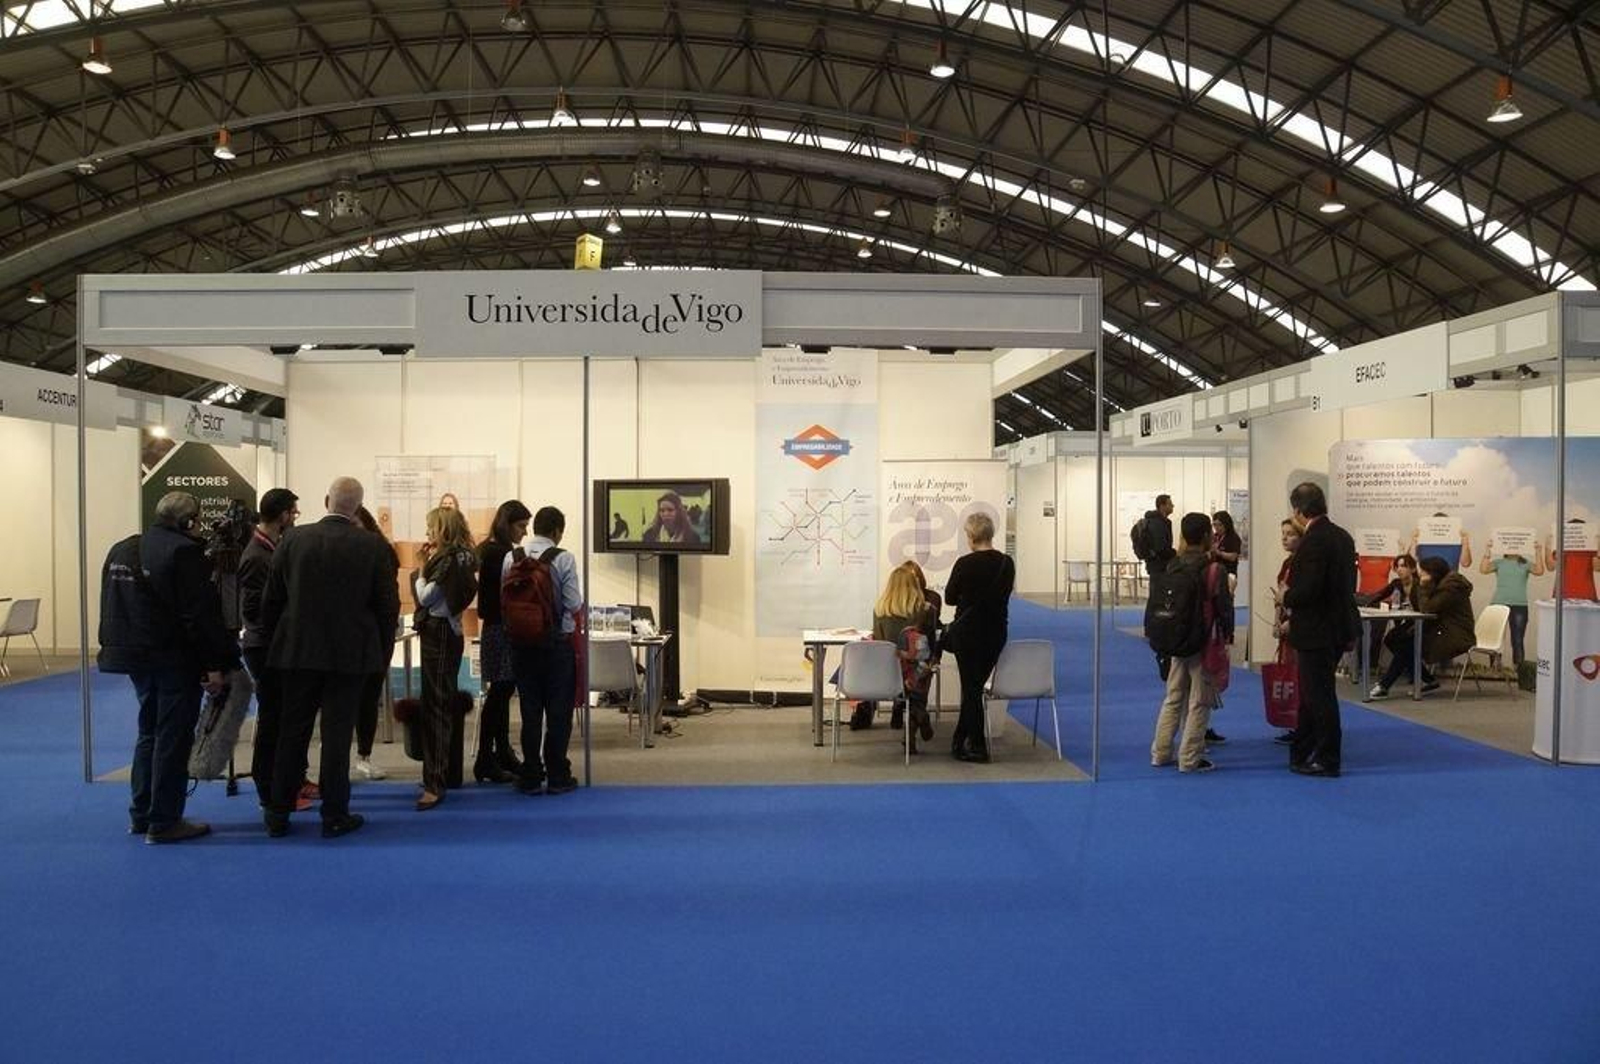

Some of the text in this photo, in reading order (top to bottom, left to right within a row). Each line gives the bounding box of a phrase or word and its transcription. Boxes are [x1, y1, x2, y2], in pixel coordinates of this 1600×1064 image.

[1355, 361, 1386, 383] EFACEC
[37, 388, 77, 407] ACCENTUR
[1312, 395, 1321, 411] B1
[1346, 469, 1431, 479] procuramos talentos
[166, 476, 229, 487] SECTORES
[1346, 480, 1361, 488] que
[1363, 478, 1391, 487] podem
[1393, 478, 1431, 487] construir
[1440, 478, 1468, 486] futuro
